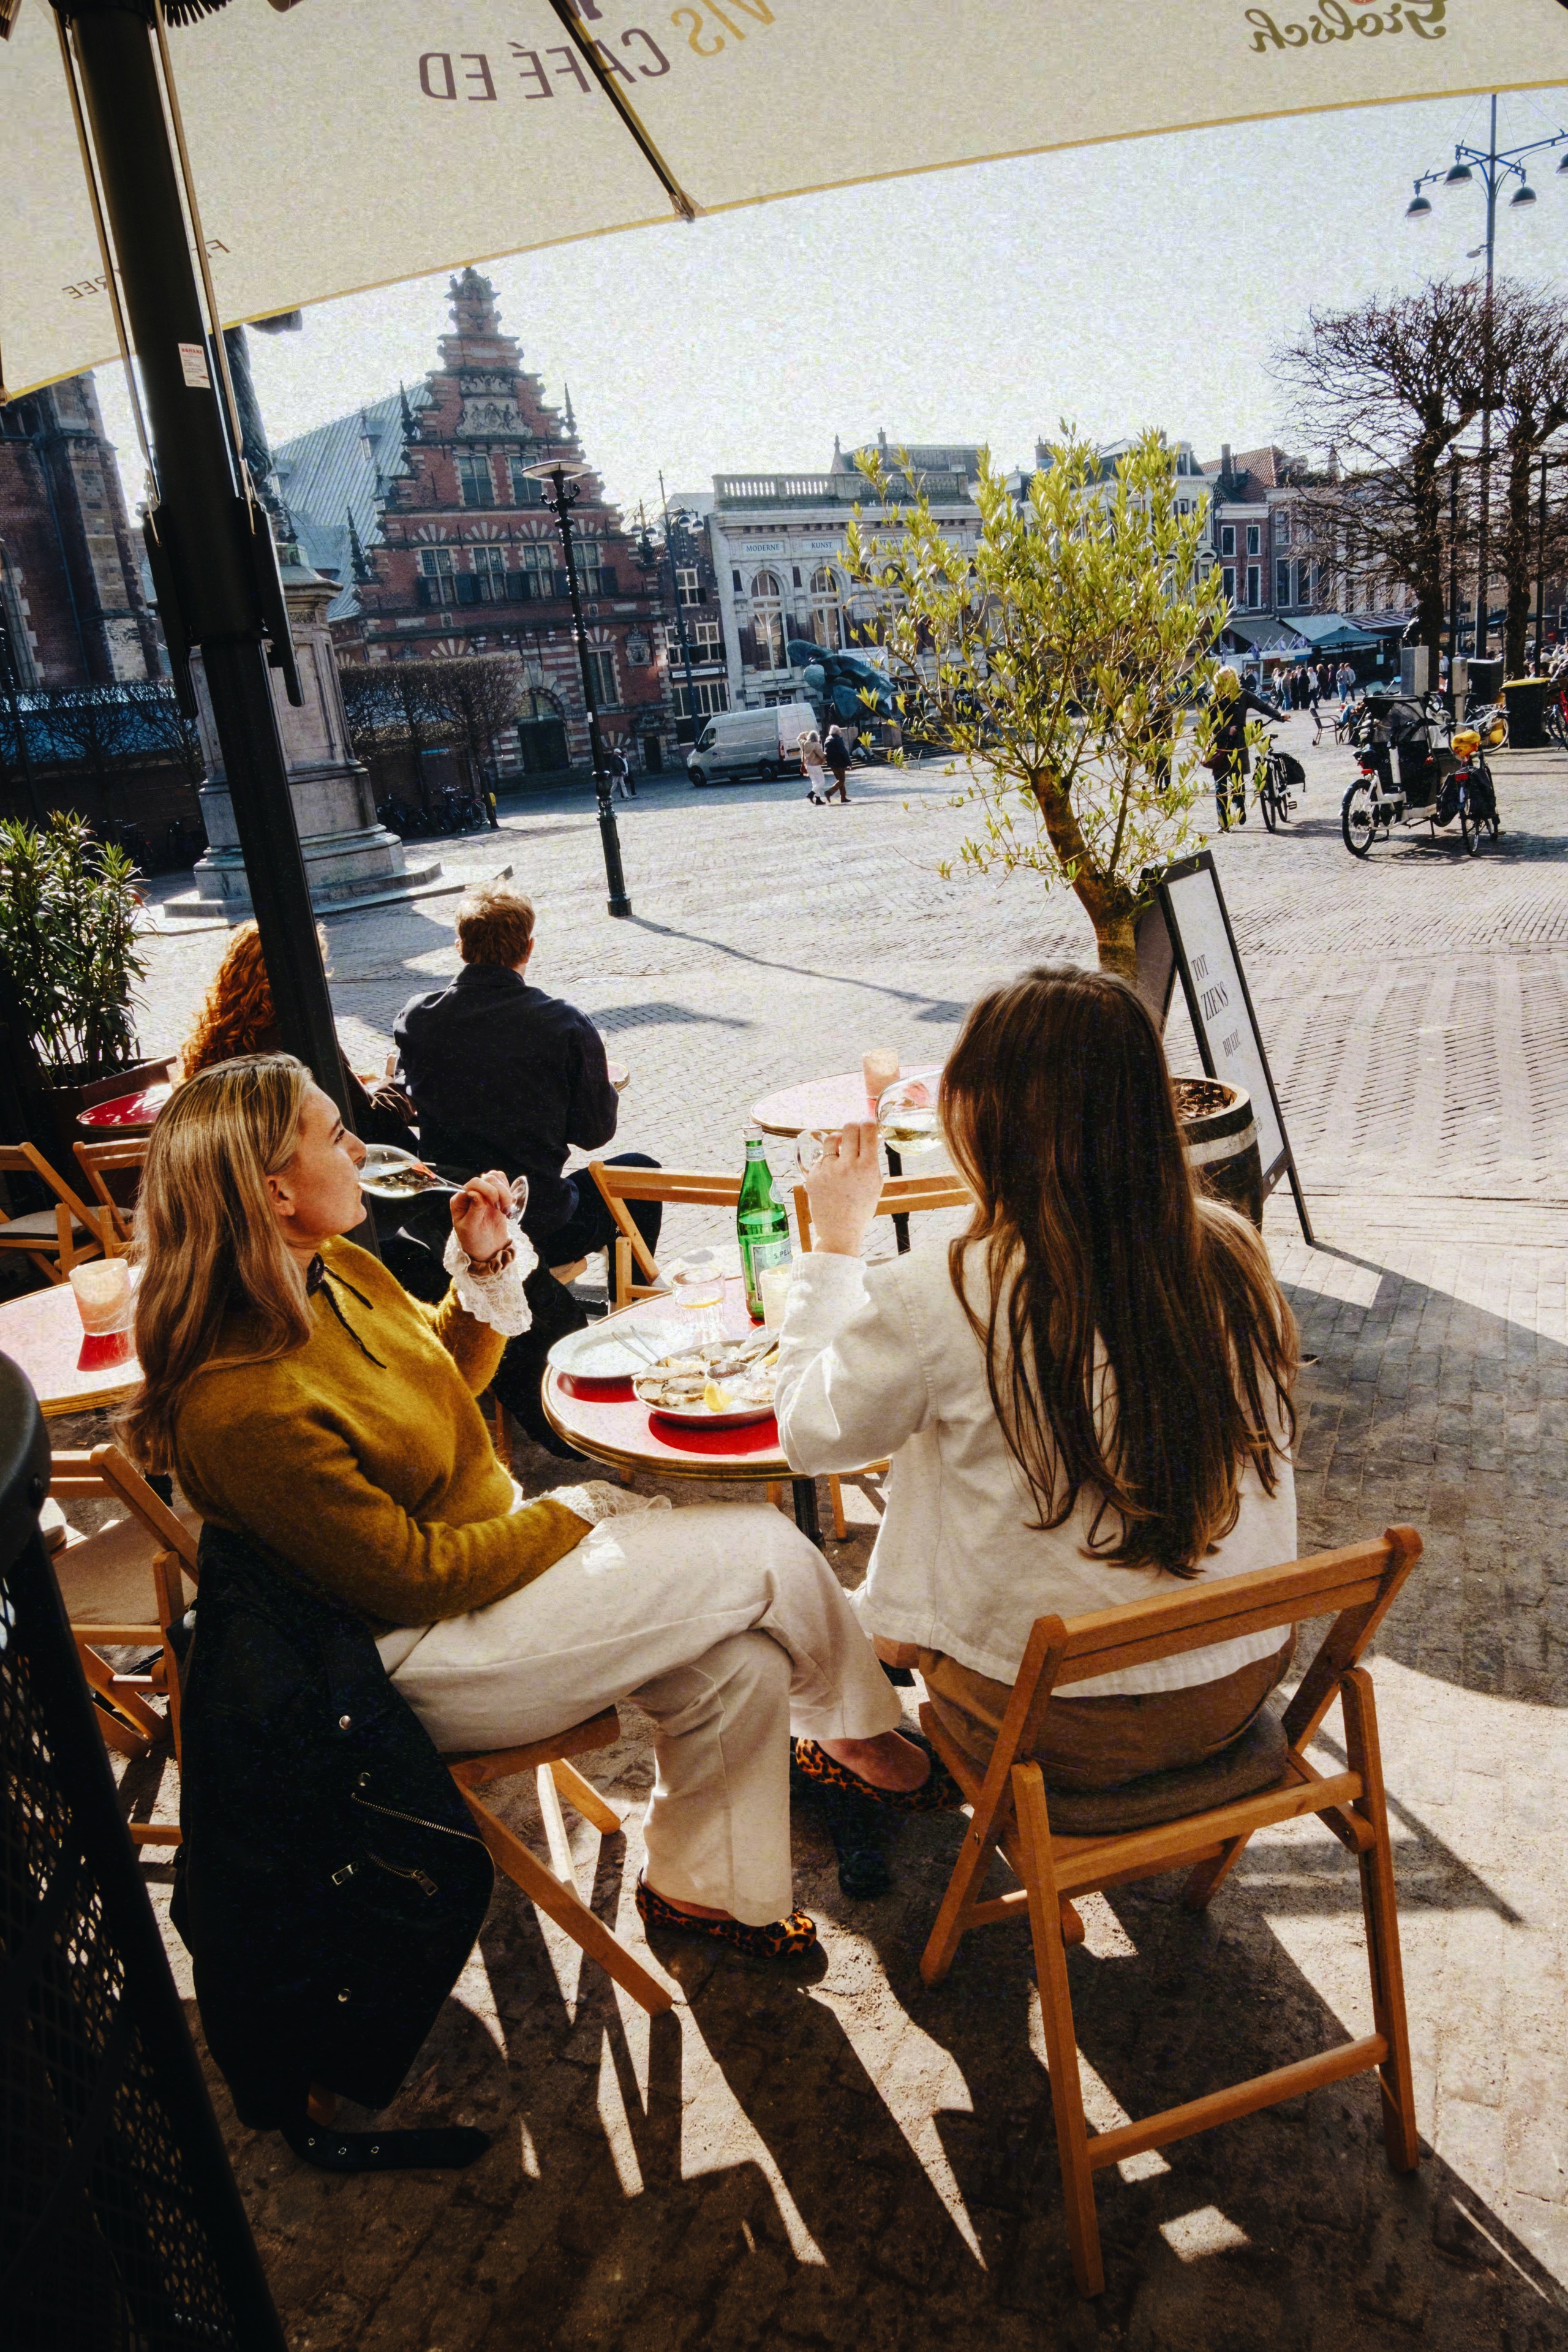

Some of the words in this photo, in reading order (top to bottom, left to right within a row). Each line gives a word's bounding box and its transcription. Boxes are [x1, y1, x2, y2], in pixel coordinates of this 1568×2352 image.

[746, 543, 780, 552] MODERNE
[1191, 954, 1209, 981] TOT
[1200, 981, 1229, 1021] ZIENS
[1223, 1037, 1234, 1057] BIJ
[1230, 1028, 1241, 1050] ED!
